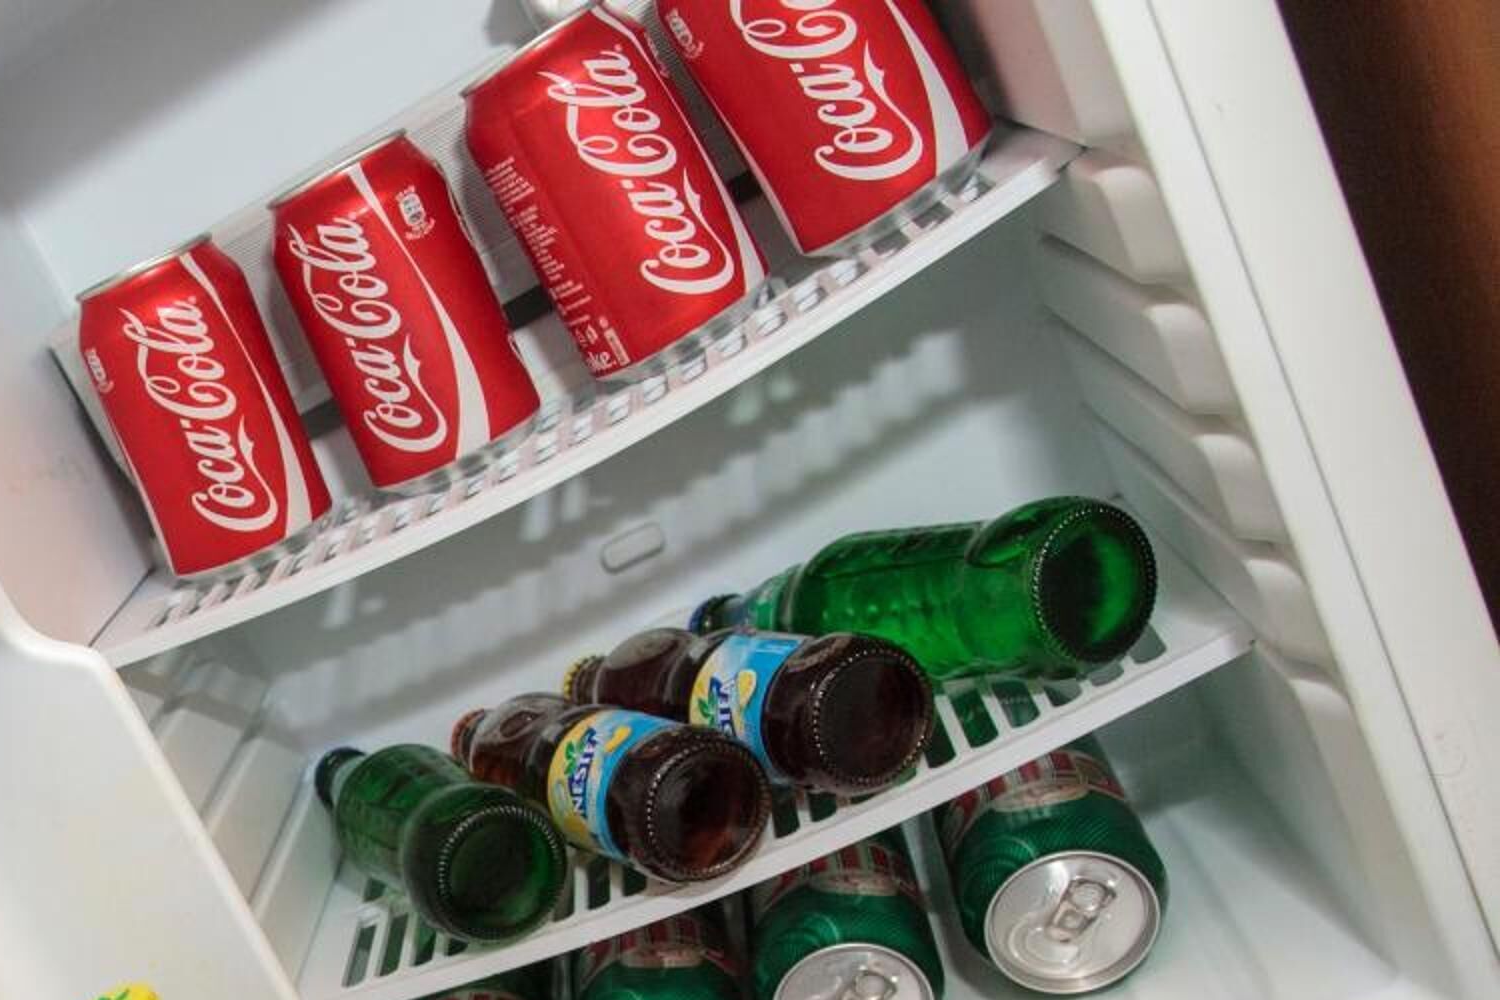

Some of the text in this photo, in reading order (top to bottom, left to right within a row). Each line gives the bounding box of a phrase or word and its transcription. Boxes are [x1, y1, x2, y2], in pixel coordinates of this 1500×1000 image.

[538, 48, 734, 295] Coca-Cola
[729, 0, 923, 181] Coca-C
[118, 297, 278, 532] Coca-Cola
[287, 210, 447, 453] Coca-Cola
